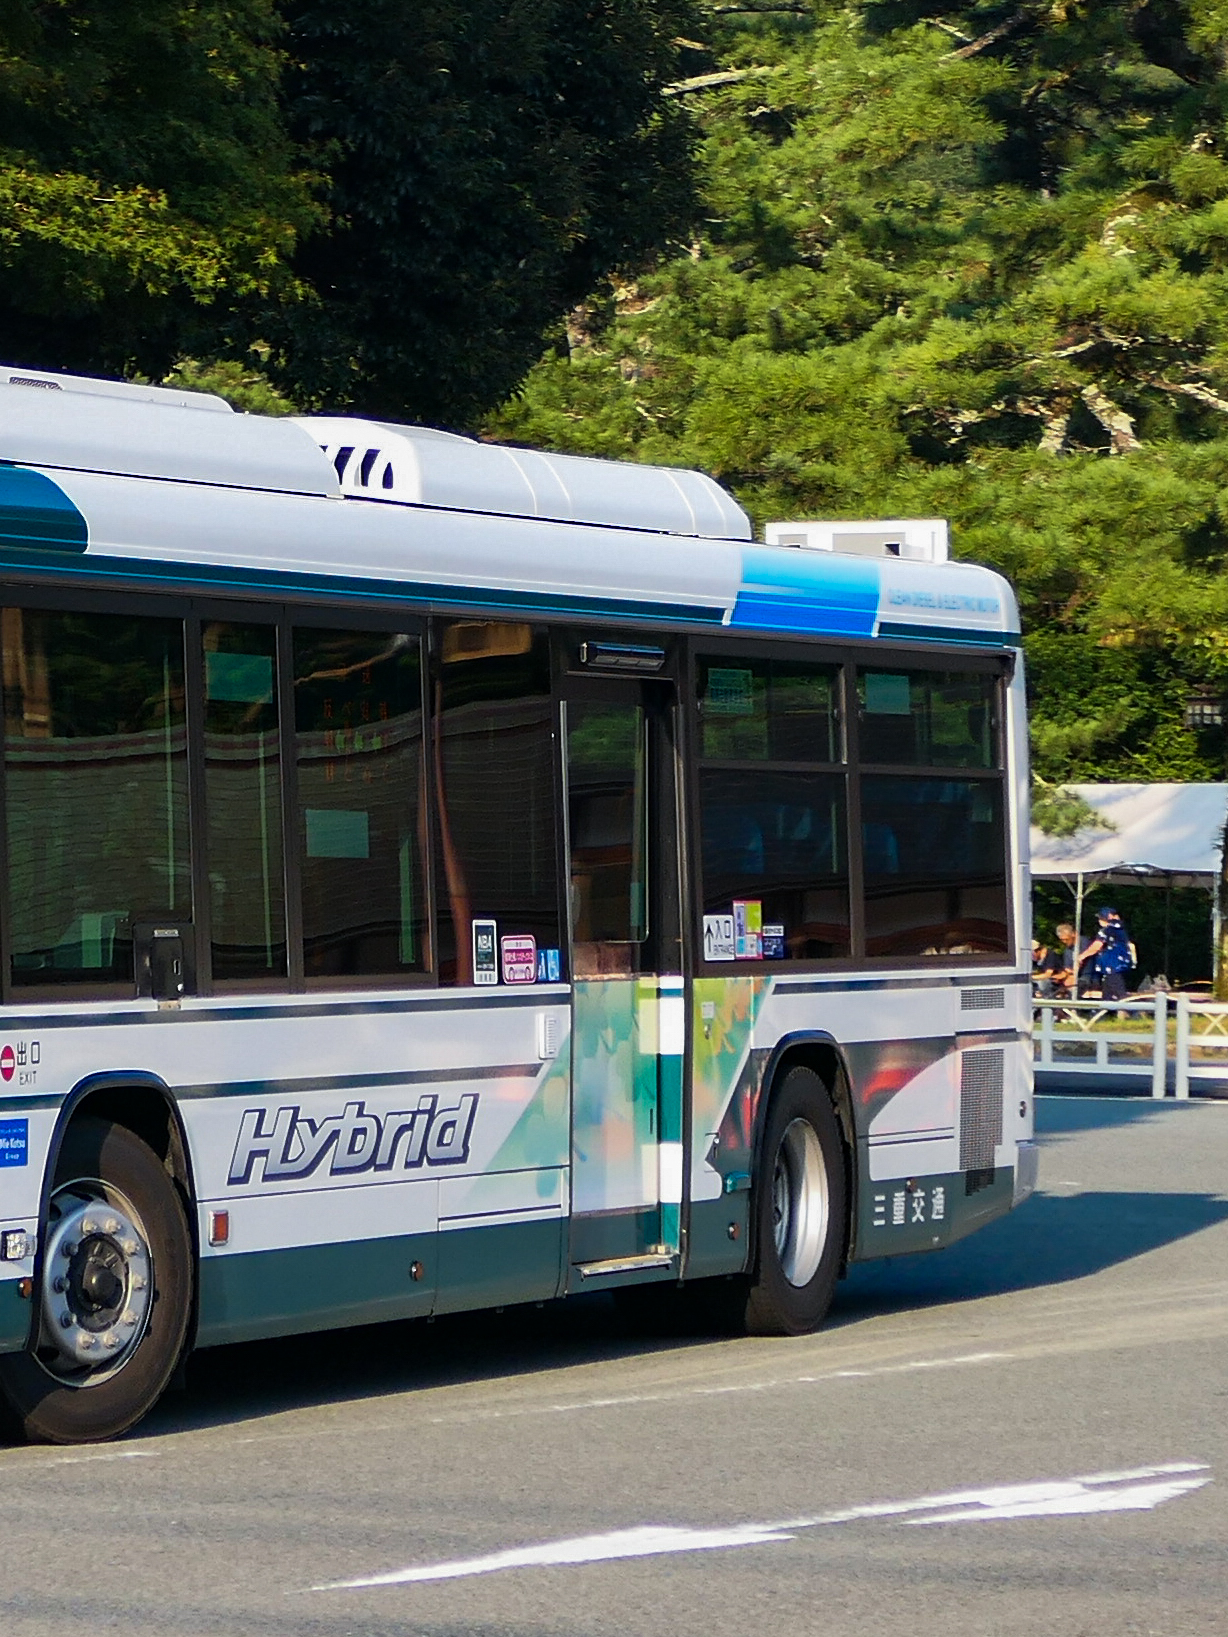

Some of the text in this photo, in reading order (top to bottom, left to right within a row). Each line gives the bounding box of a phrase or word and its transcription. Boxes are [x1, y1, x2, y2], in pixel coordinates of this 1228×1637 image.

[16, 1041, 40, 1065] 出口
[19, 1070, 37, 1085] EXIT
[227, 1092, 480, 1186] Hybrid
[873, 1187, 944, 1226] 三重交通
